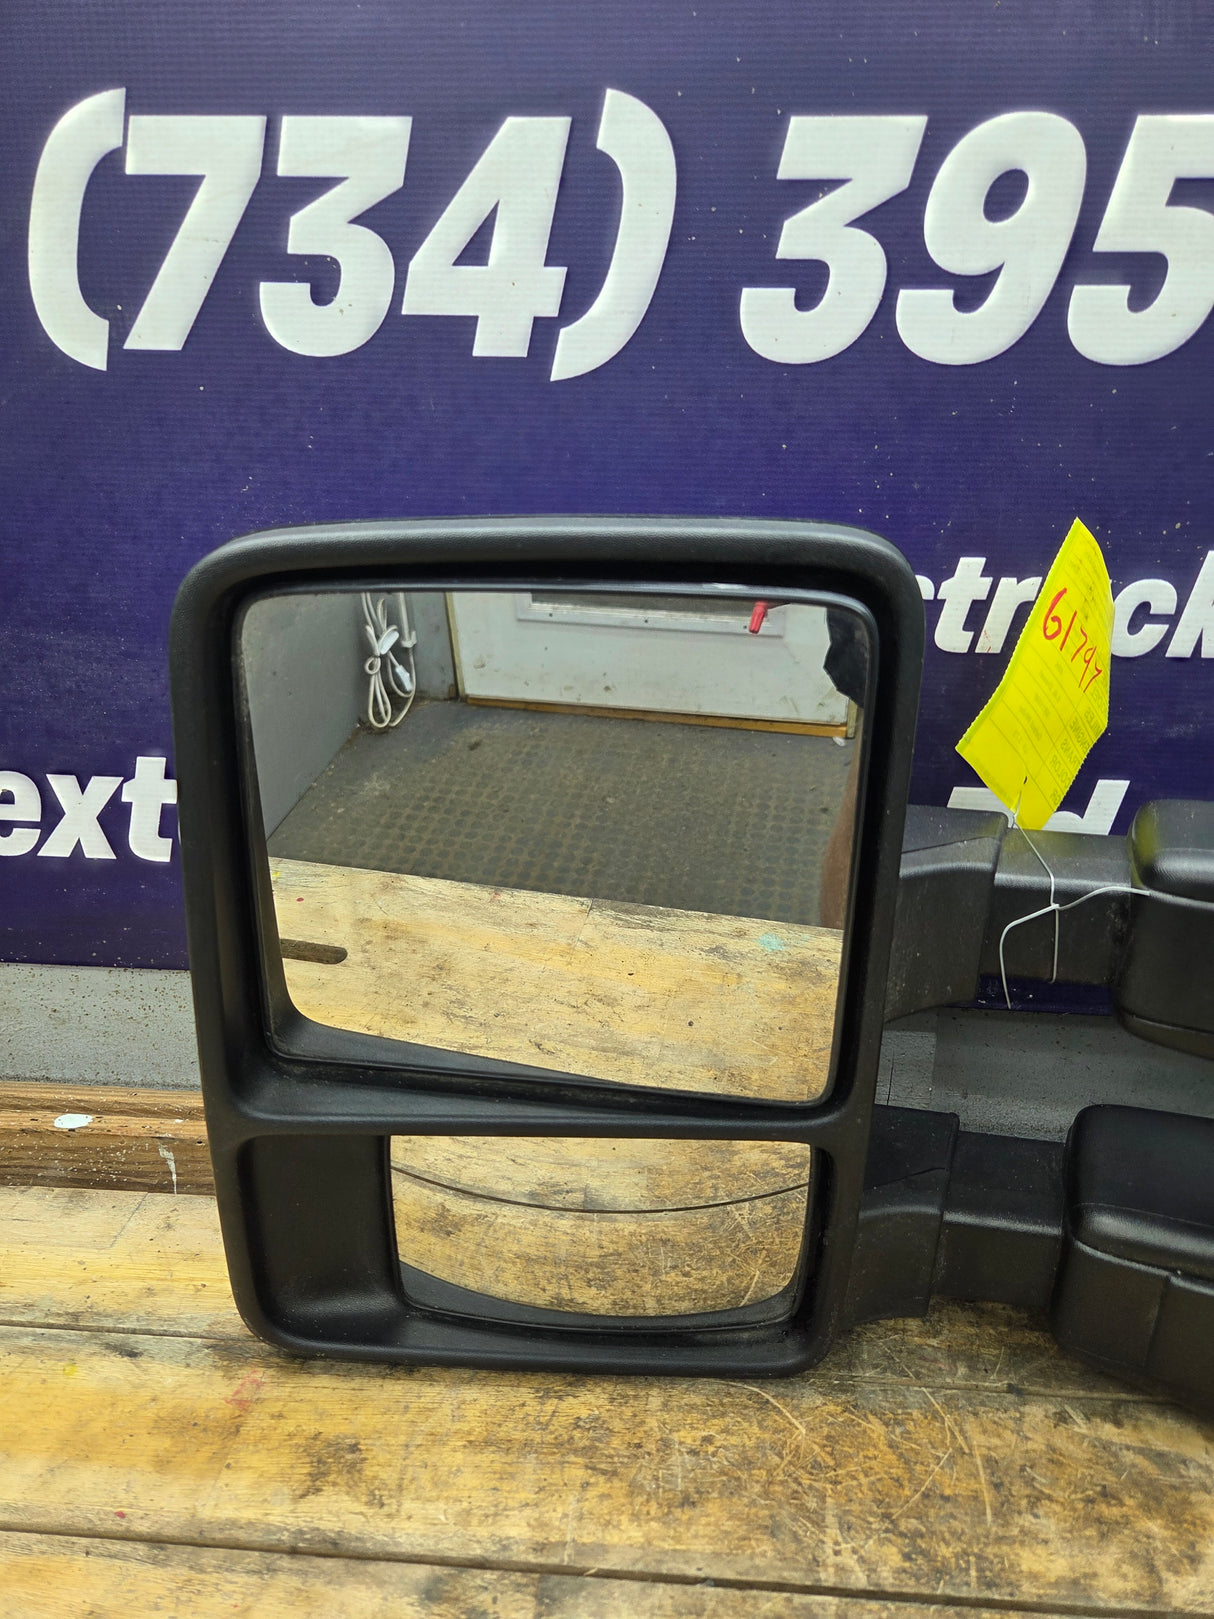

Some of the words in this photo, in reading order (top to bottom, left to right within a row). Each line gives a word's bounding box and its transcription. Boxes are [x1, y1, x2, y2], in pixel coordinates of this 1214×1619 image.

[28, 87, 677, 382] (734)
[740, 111, 1214, 366] 395
[915, 550, 1214, 659] trck
[0, 756, 181, 862] ext
